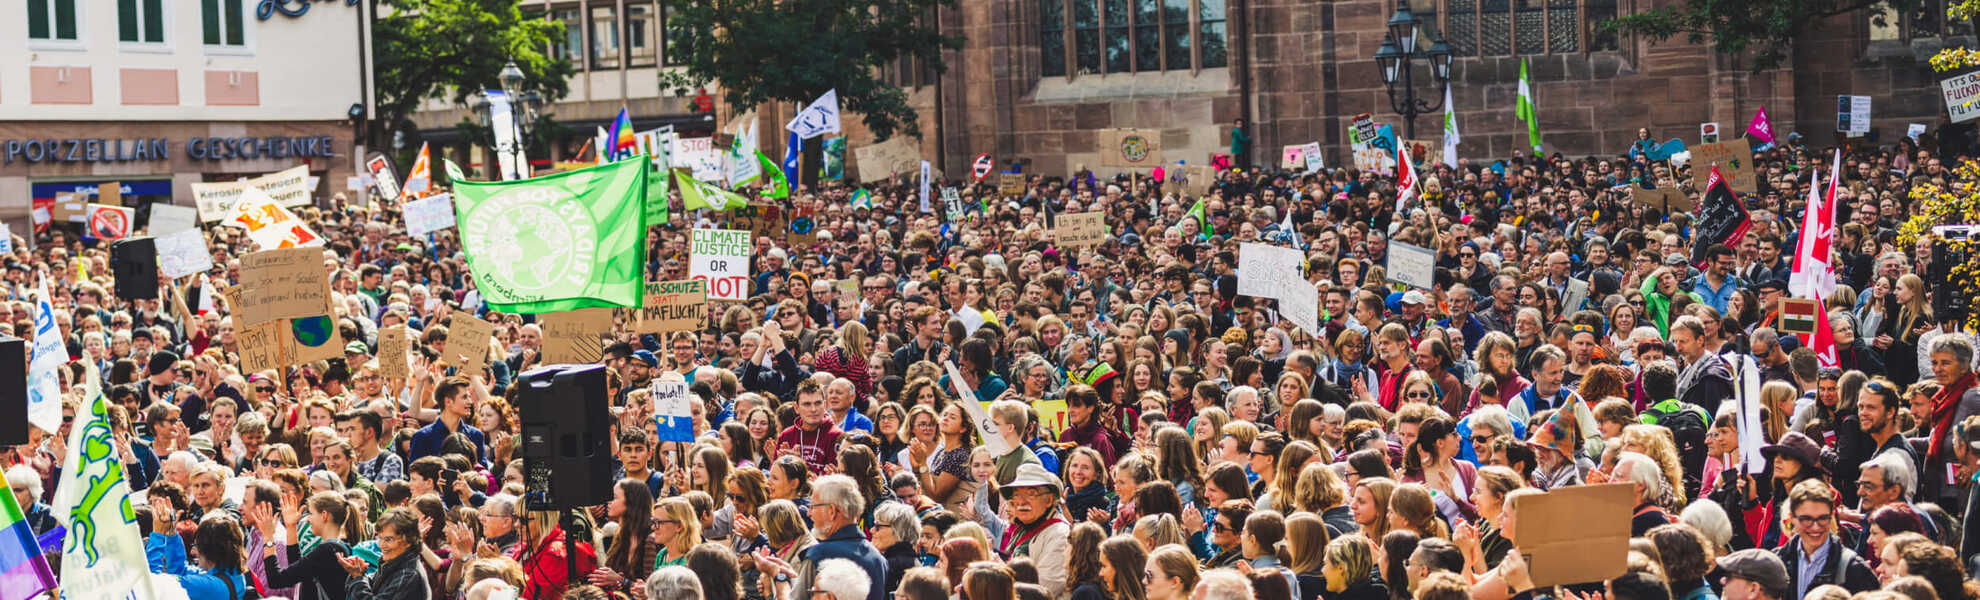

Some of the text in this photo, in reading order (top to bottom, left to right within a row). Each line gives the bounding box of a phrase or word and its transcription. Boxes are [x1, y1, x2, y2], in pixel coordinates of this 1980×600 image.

[4, 136, 337, 162] PORZELLAN GESCHENKE
[255, 176, 302, 191] steuern
[693, 230, 749, 245] CLIMATE
[692, 243, 749, 257] JUSTICE
[710, 260, 728, 272] OR
[644, 281, 700, 294] MASCHUTZ
[652, 294, 681, 304] STATT
[629, 302, 705, 321] KIMAFLUCHT
